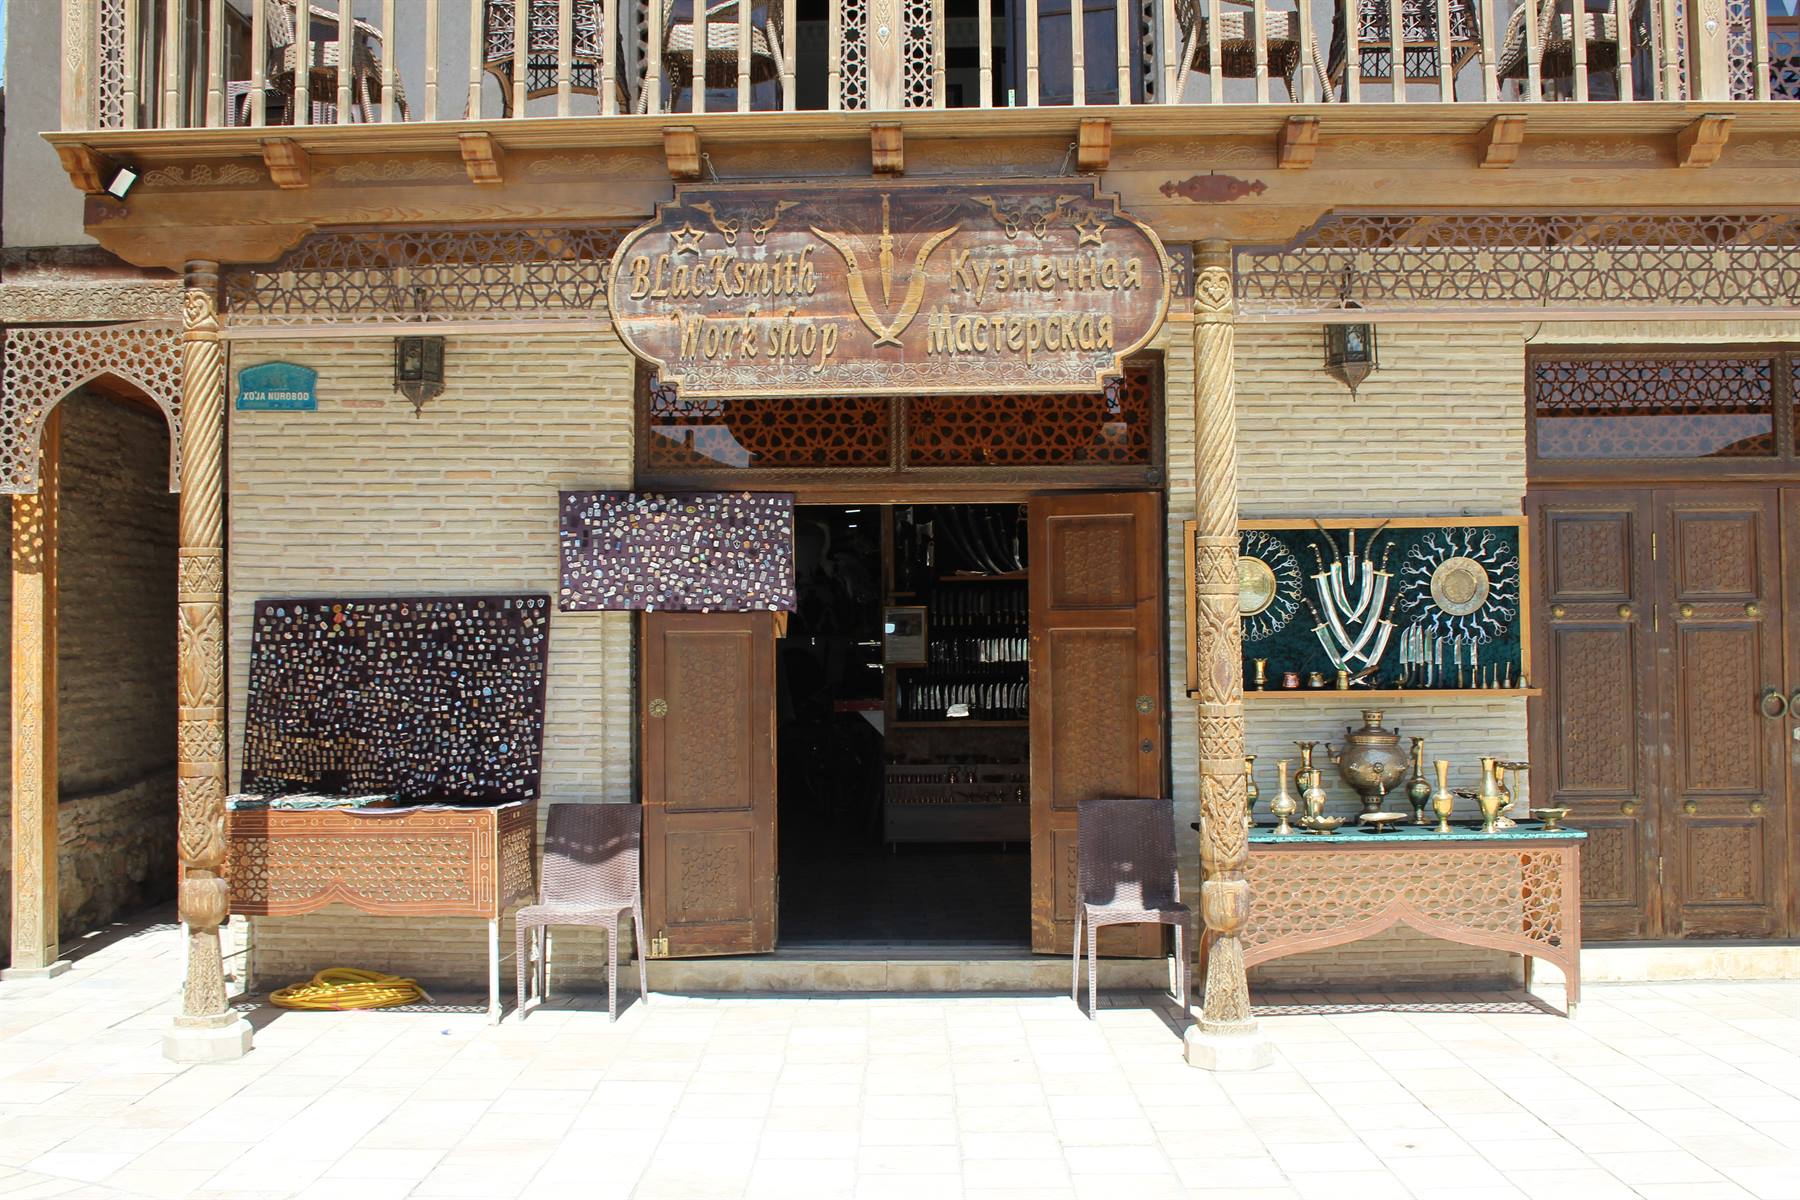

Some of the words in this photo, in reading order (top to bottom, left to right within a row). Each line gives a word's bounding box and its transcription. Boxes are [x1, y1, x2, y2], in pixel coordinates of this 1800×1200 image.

[950, 247, 1142, 305] Кузнечная
[927, 303, 1116, 369] Мастерская
[268, 391, 310, 401] NUROBOD
